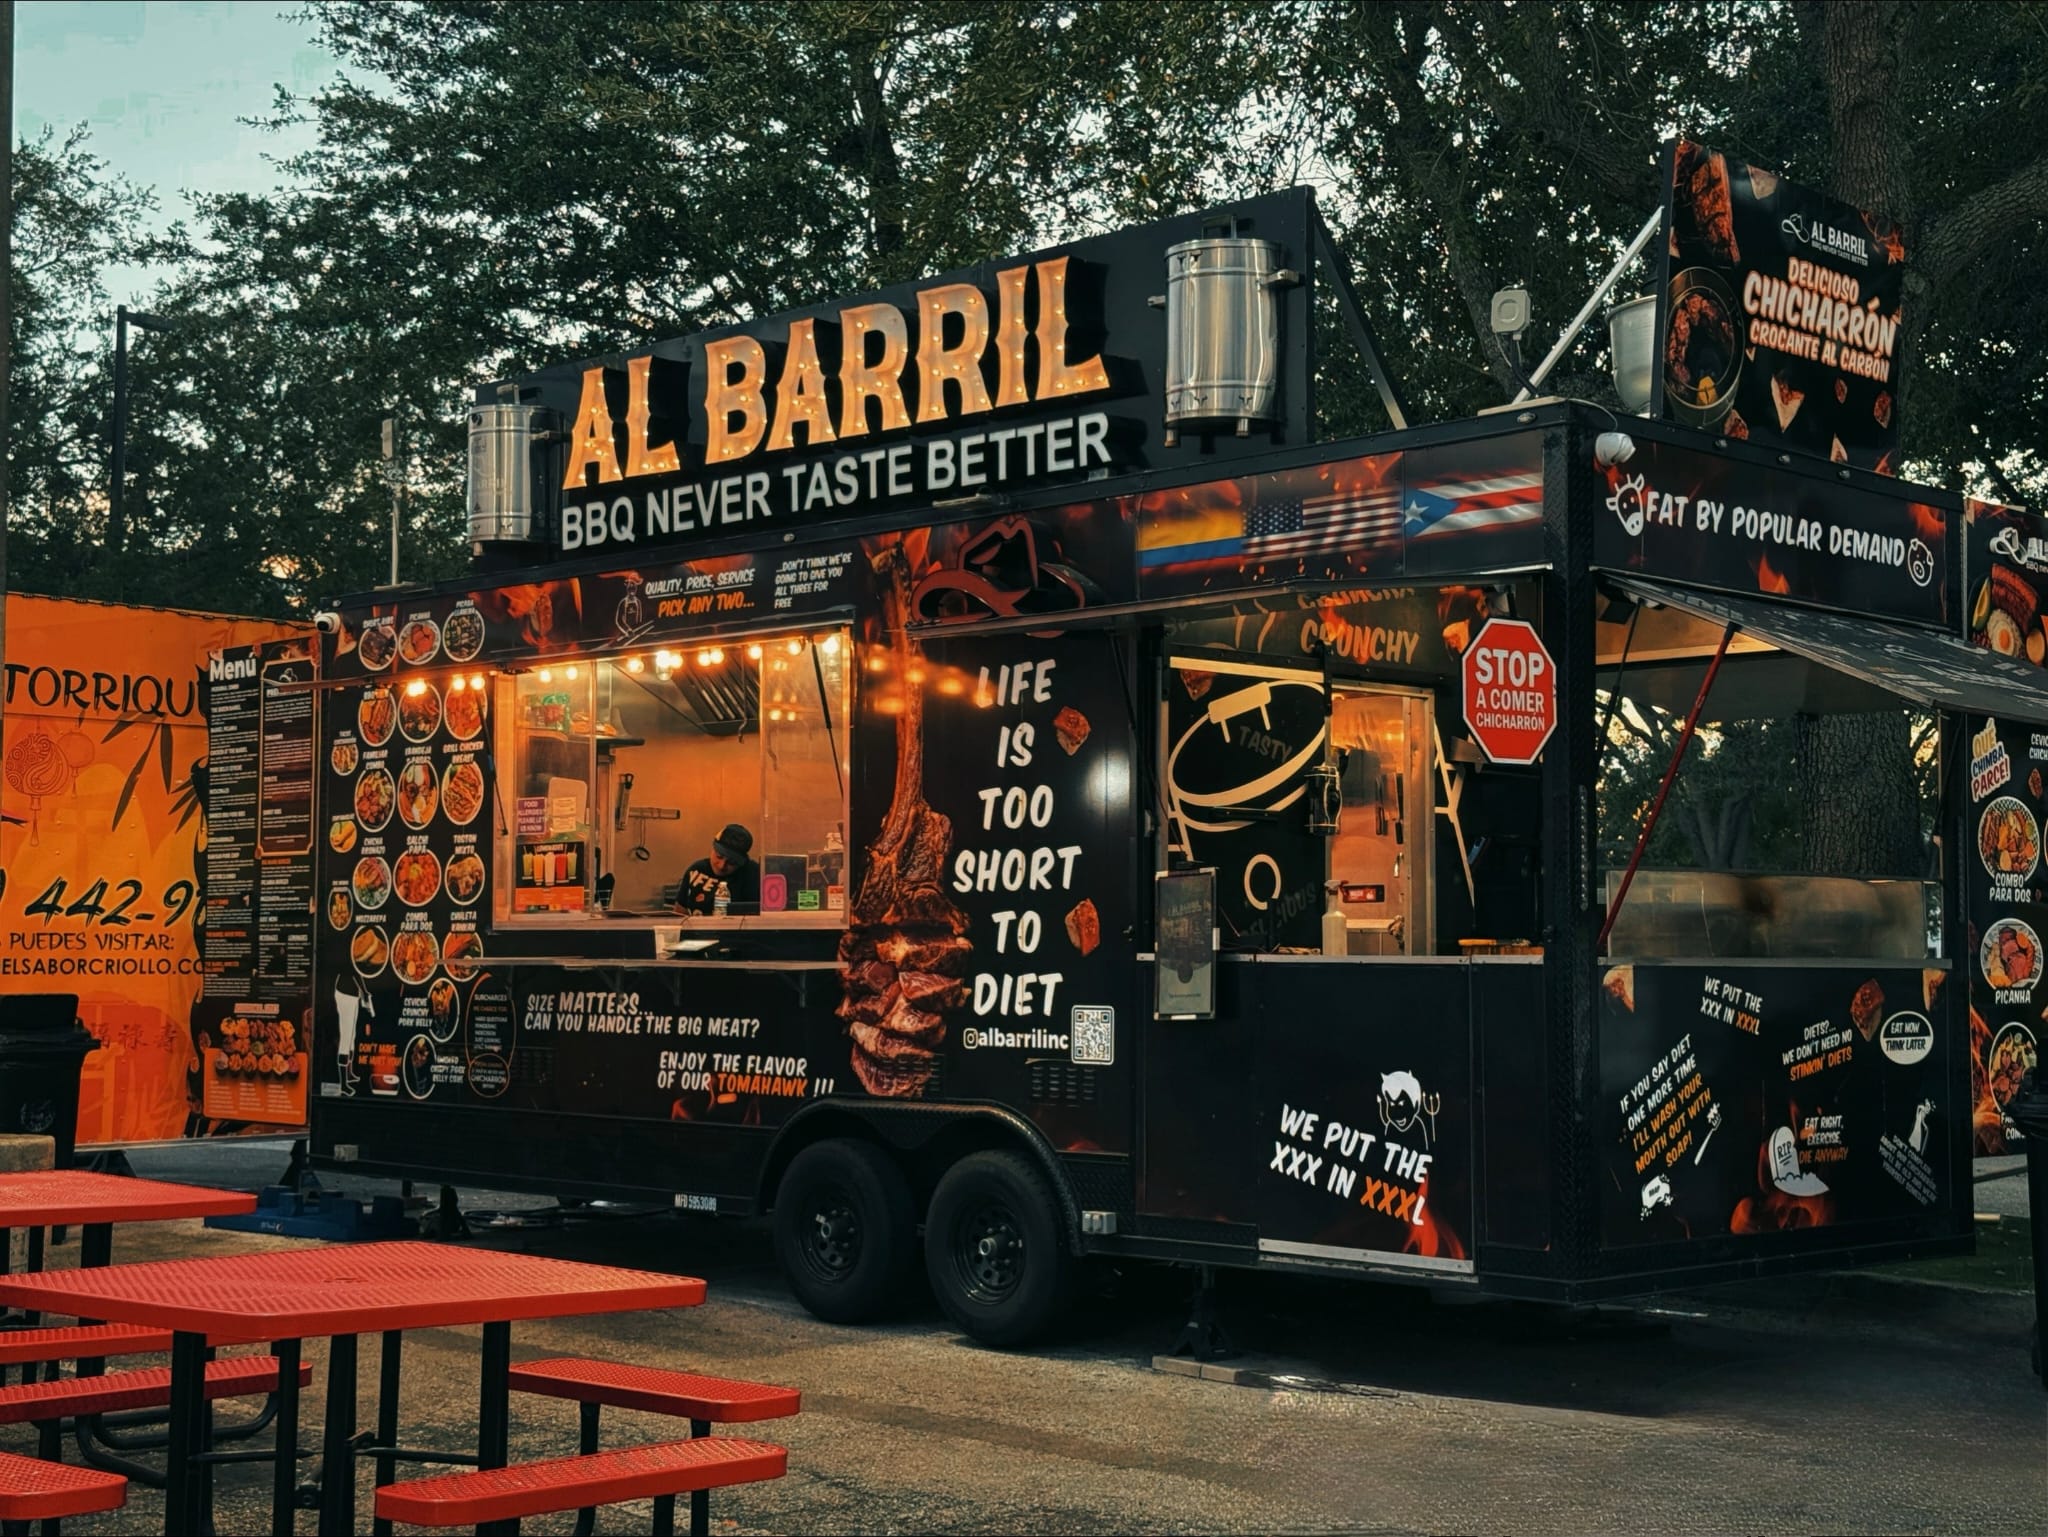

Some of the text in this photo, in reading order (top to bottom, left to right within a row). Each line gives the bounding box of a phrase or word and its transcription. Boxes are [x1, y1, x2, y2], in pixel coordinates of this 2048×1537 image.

[1812, 221, 1868, 258] AL BARRIL
[1788, 256, 1860, 305] DELICIOSO
[1743, 270, 1897, 358] CHICHARRÓN
[1750, 320, 1890, 383] CROCANTE AL CARBÓN
[562, 255, 1111, 490] AL BARRIL
[562, 411, 1112, 551] BBQ NEVER TASTE BETTER
[1645, 491, 1906, 567] FAT BY POPULAR DEMAND
[645, 568, 755, 596] QUALITY, PRICE, SERVICE
[774, 580, 829, 597] ALL THREE FOR
[775, 566, 843, 586] GOING TO GIVE YOU
[658, 591, 755, 619] PICK ANY TWO...
[774, 597, 792, 609] FREE
[209, 651, 257, 683] Menú
[975, 658, 1057, 709] LIFE
[1475, 647, 1546, 689] STOP
[3, 663, 199, 718] TORRIQU
[1476, 689, 1546, 714] A COMER
[1475, 711, 1547, 732] CHICHARRÓN
[996, 721, 1035, 769] IS
[1972, 745, 2005, 777] CHIMBA
[1972, 758, 2010, 799] PARCE!
[977, 784, 1055, 831] TOO
[952, 845, 1083, 894] SHORT
[1995, 872, 2024, 888] COMBO
[1989, 887, 2032, 903] PARA DOS
[10, 931, 175, 951] PUEDES VISITAR:
[991, 909, 1043, 955] TO
[526, 994, 555, 1013] SIZE
[972, 971, 1064, 1017] DIET
[1704, 975, 1763, 1014] WE PUT THE
[1995, 989, 2032, 1005] PICANHA
[524, 1013, 552, 1031] CAN
[556, 1013, 583, 1032] YOU
[587, 1014, 641, 1034] HANDLE
[645, 1014, 673, 1036] THE
[677, 1016, 702, 1037] BIG
[707, 1018, 760, 1039] MEAT?
[1700, 998, 1761, 1036] XXX IN XXXL
[1891, 1021, 1921, 1034] EAT NOW
[1782, 1029, 1853, 1066] WE DON'T NEED NO
[1885, 1038, 1926, 1052] THINK LATER
[659, 1051, 808, 1078] ENJOY THE FLAVOR
[1619, 1033, 1692, 1114] IF YOU SAY DIET
[1789, 1046, 1853, 1082] STINKIN' DIETS
[657, 1071, 677, 1090] OF
[681, 1070, 711, 1091] OUR
[717, 1073, 810, 1098] TOMAHAWK
[1627, 1053, 1697, 1132] ONE MORE TIME
[1633, 1072, 1703, 1152] I'LL WASH YOUR
[1804, 1116, 1819, 1130] EAT
[1280, 1103, 1433, 1184] WE PUT THE
[1635, 1087, 1712, 1175] MOUTH OUT WITH
[1665, 1129, 1694, 1168] SOAP!
[1776, 1140, 1793, 1160] RIP
[1814, 1146, 1848, 1162] ANYWAY
[1269, 1141, 1426, 1226] XXX IN XXXL
